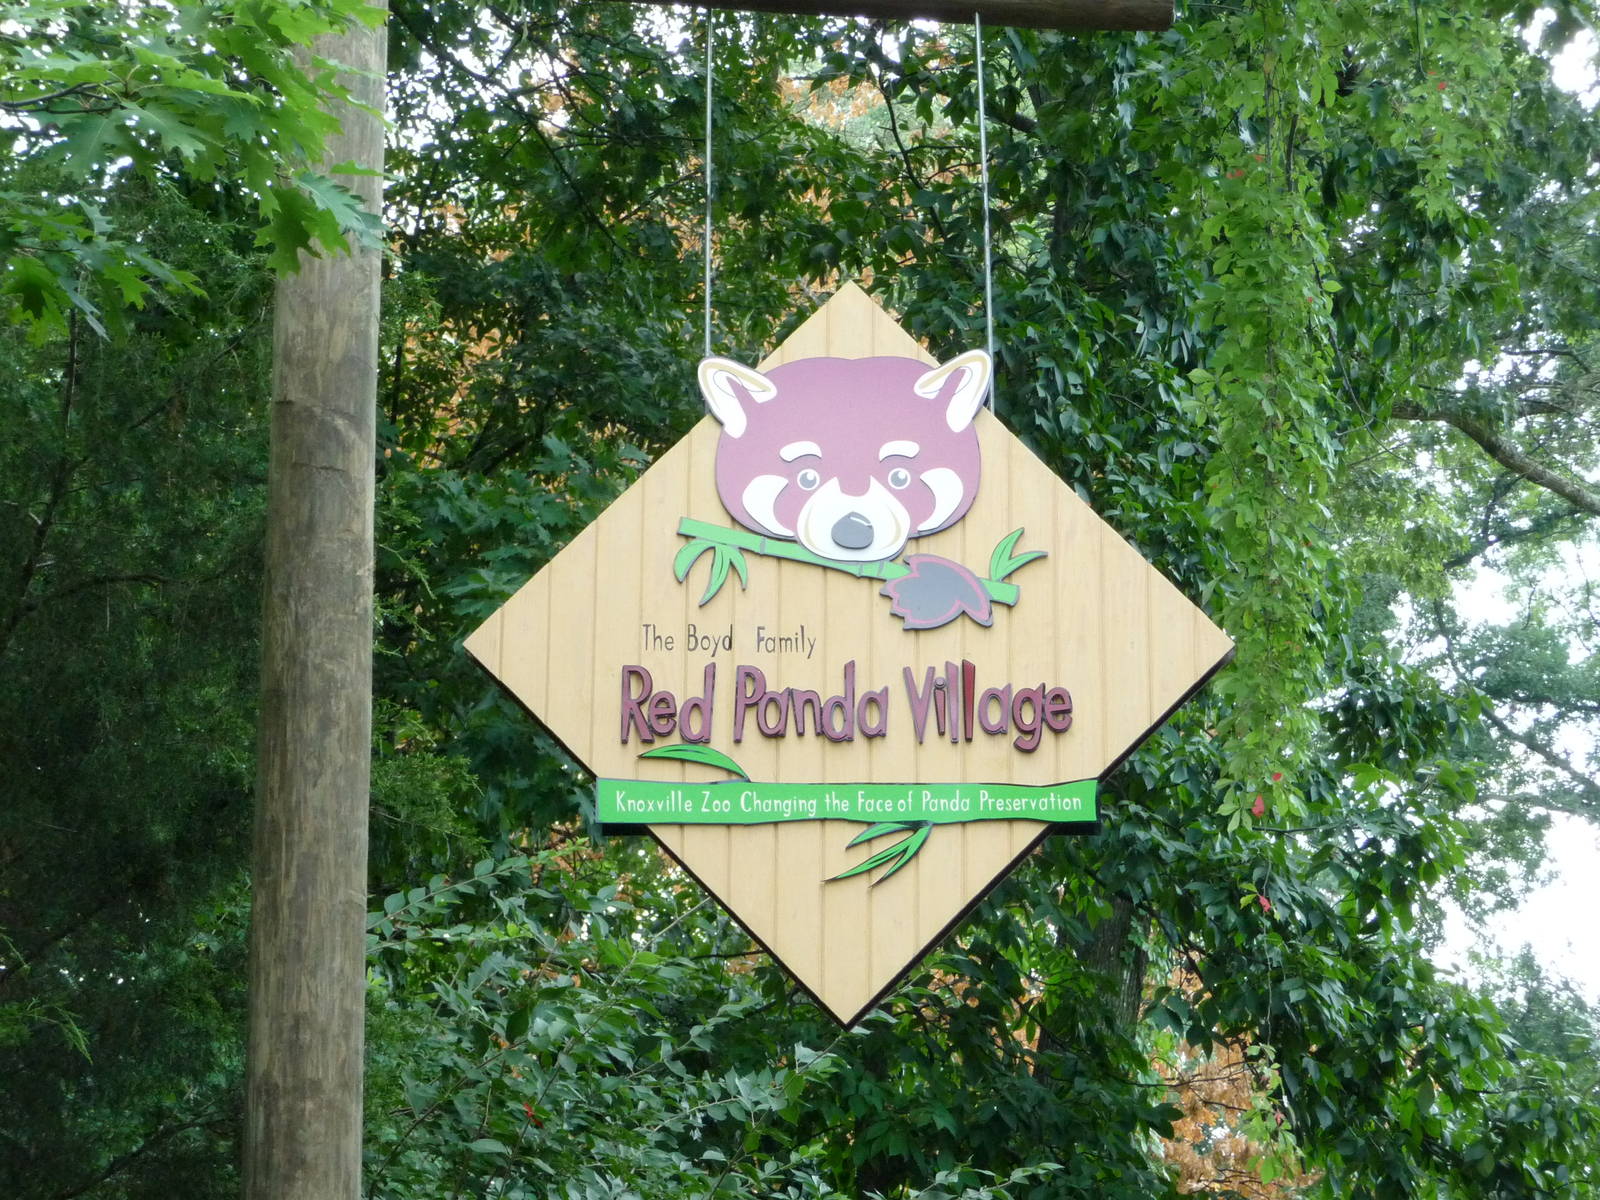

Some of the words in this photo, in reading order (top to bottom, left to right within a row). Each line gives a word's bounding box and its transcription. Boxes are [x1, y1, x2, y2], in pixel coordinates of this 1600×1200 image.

[642, 624, 674, 651] The
[687, 624, 733, 657] Boyd
[756, 625, 817, 659] Family
[620, 661, 716, 744] Red
[733, 659, 889, 743] Panda
[902, 659, 1074, 753] Village
[616, 790, 693, 813] Knoxville
[701, 790, 731, 813] Zoo
[740, 791, 817, 817] Changing
[825, 793, 849, 812] the
[857, 790, 893, 812] Face
[897, 791, 913, 812] of
[922, 789, 970, 812] Panda
[979, 790, 1082, 811] Preservation
